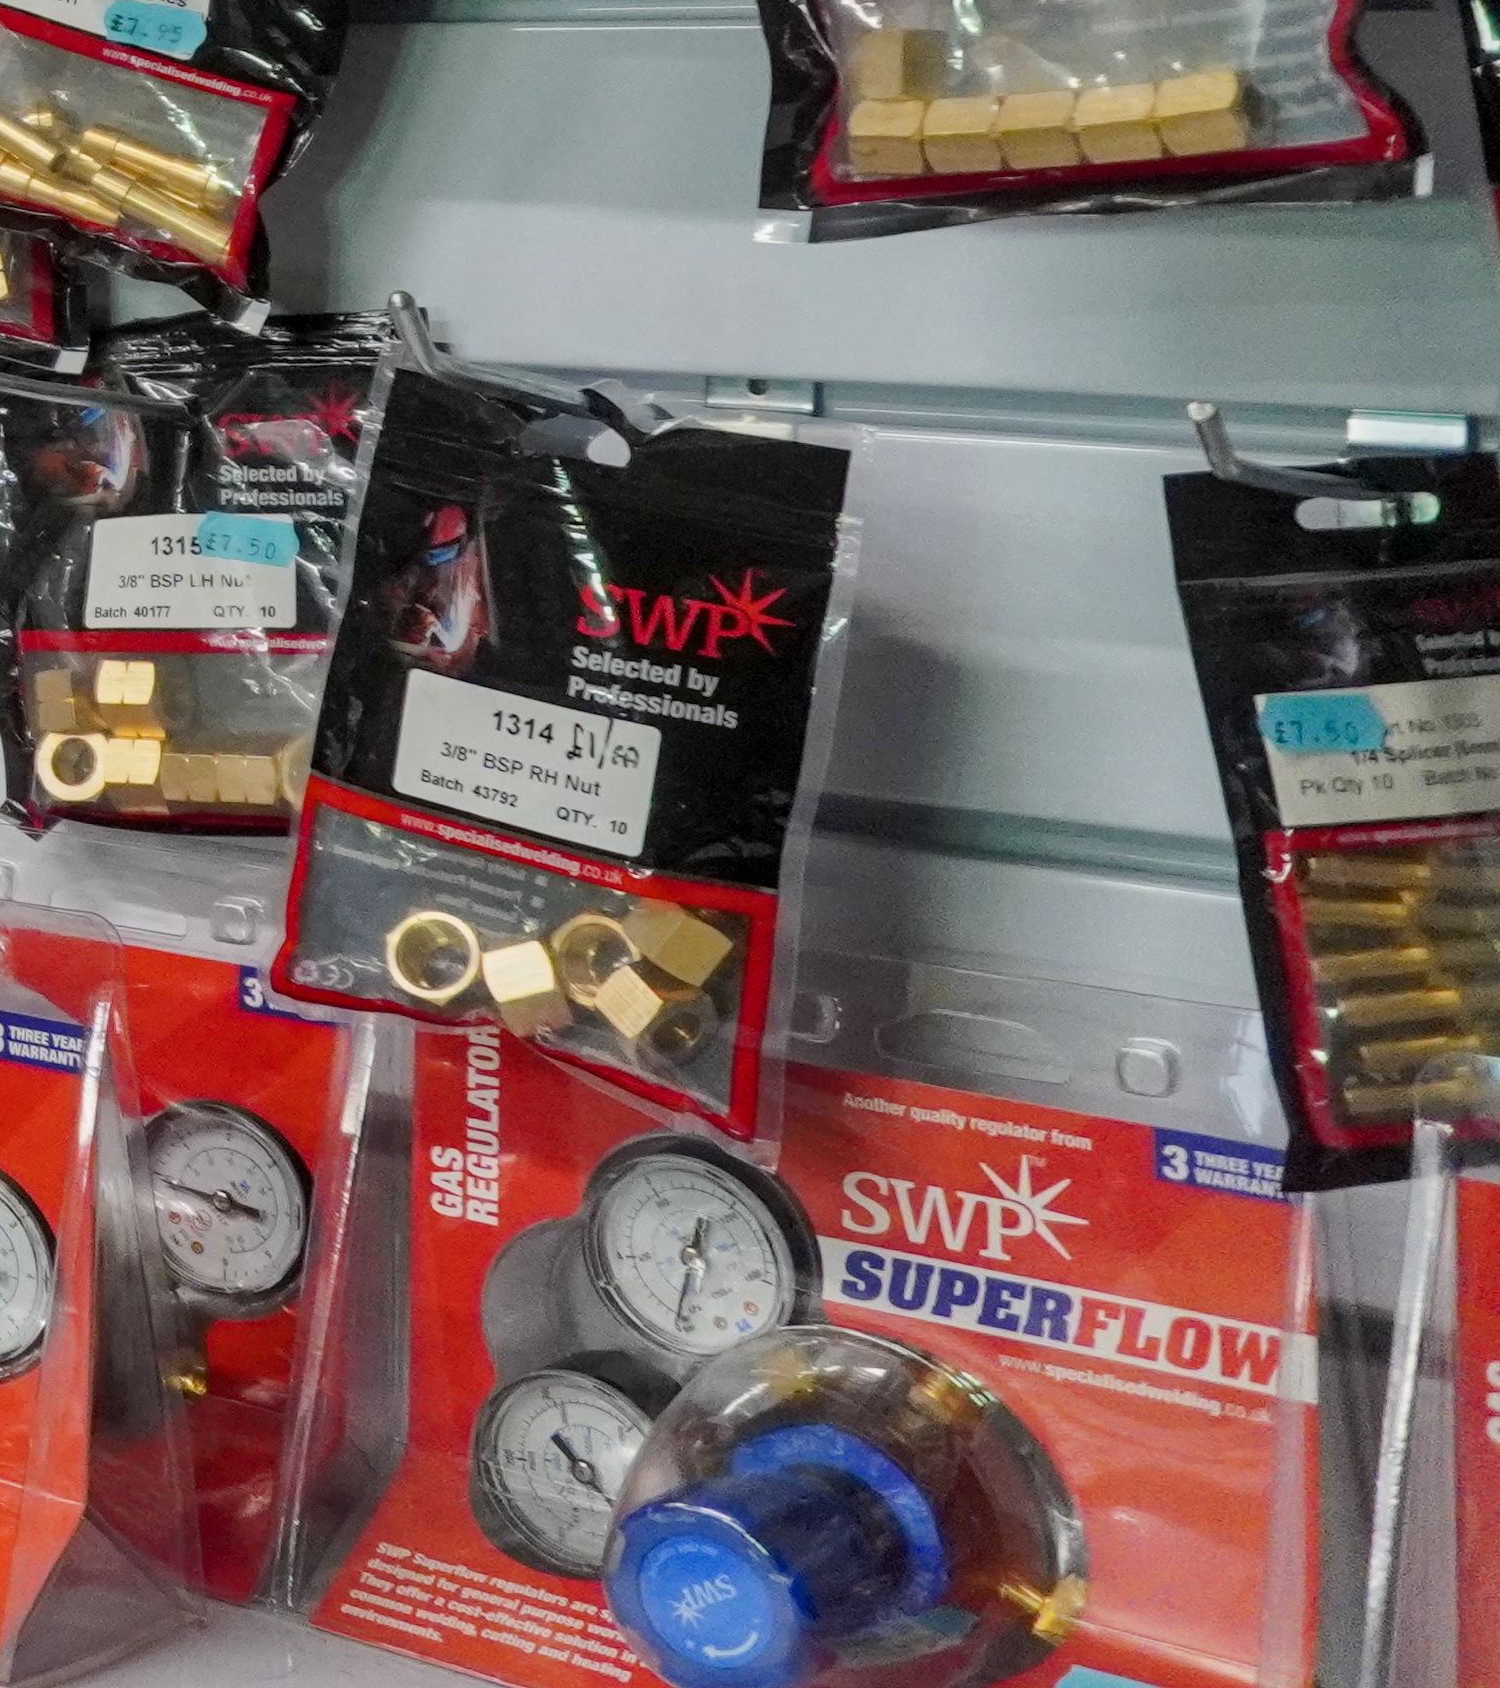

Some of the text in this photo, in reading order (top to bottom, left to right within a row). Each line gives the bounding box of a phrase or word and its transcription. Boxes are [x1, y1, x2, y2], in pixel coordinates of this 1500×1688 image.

[220, 465, 326, 486] Selected by
[221, 488, 344, 507] Professionals
[151, 535, 203, 556] 1315
[576, 582, 747, 660] SWP
[571, 645, 720, 698] Selected by
[493, 710, 554, 744] 1314
[567, 675, 738, 730] Professionals
[483, 752, 523, 777] BSP
[529, 764, 558, 786] RH
[565, 774, 602, 798] Nut
[421, 769, 628, 836] Batch 43792 QTY. 10
[842, 1092, 1092, 1151] Another quality regulator from
[428, 1146, 464, 1219] GAS
[1161, 1144, 1189, 1180] 3
[841, 1171, 1036, 1262] SWP
[841, 1250, 1282, 1386] SUPERFLOW
